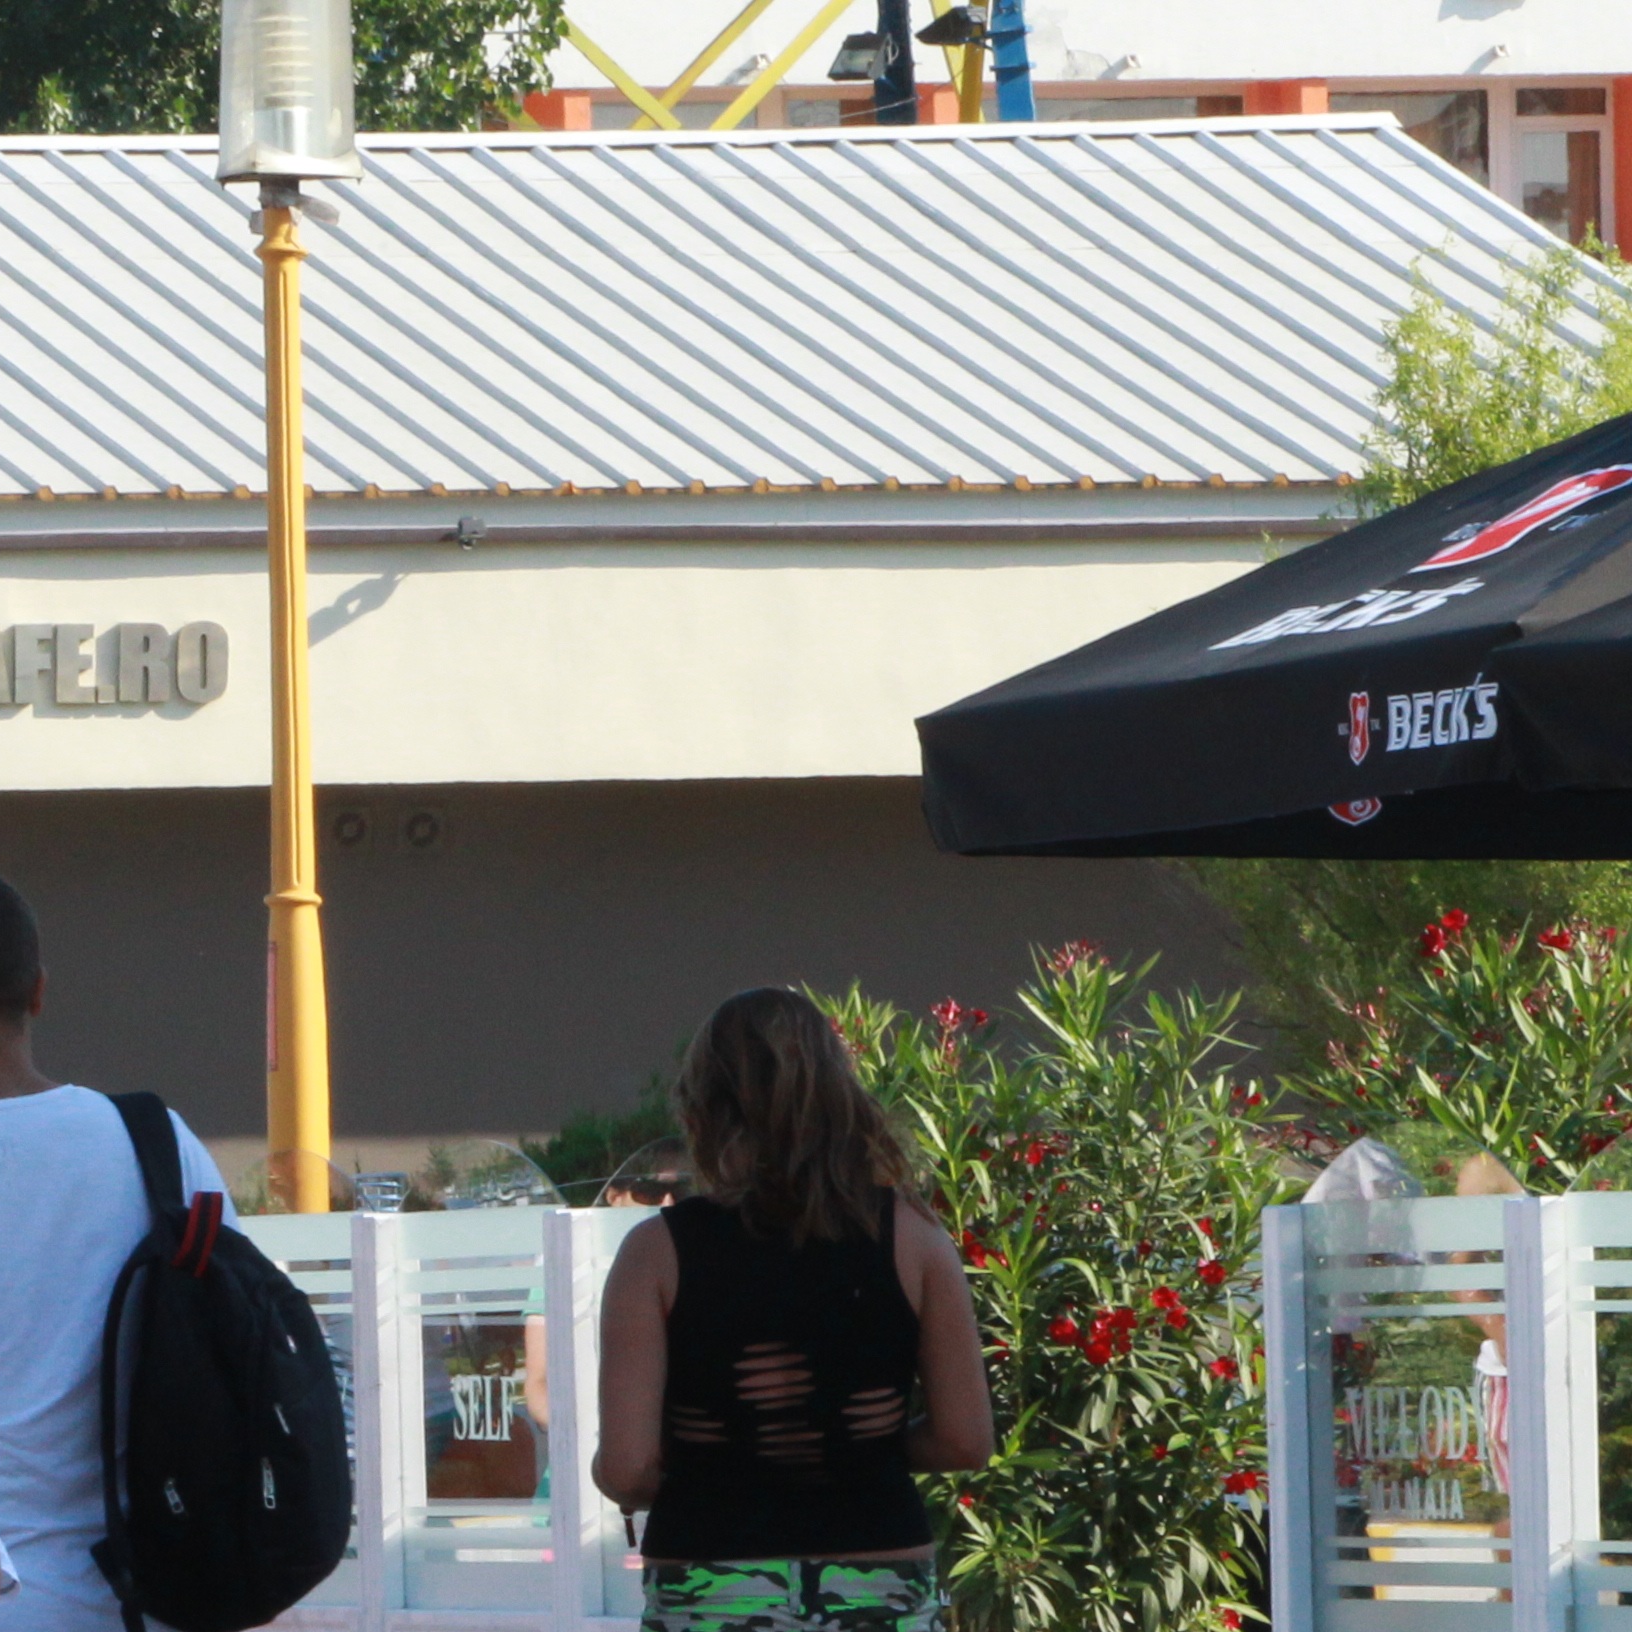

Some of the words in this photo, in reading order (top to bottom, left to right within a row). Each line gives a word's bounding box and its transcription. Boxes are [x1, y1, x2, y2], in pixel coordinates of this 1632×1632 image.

[1386, 672, 1499, 752] BECK'S
[449, 1374, 515, 1441] SELF
[1345, 1385, 1489, 1461] MELODY
[1369, 1477, 1464, 1520] MAMAIA
